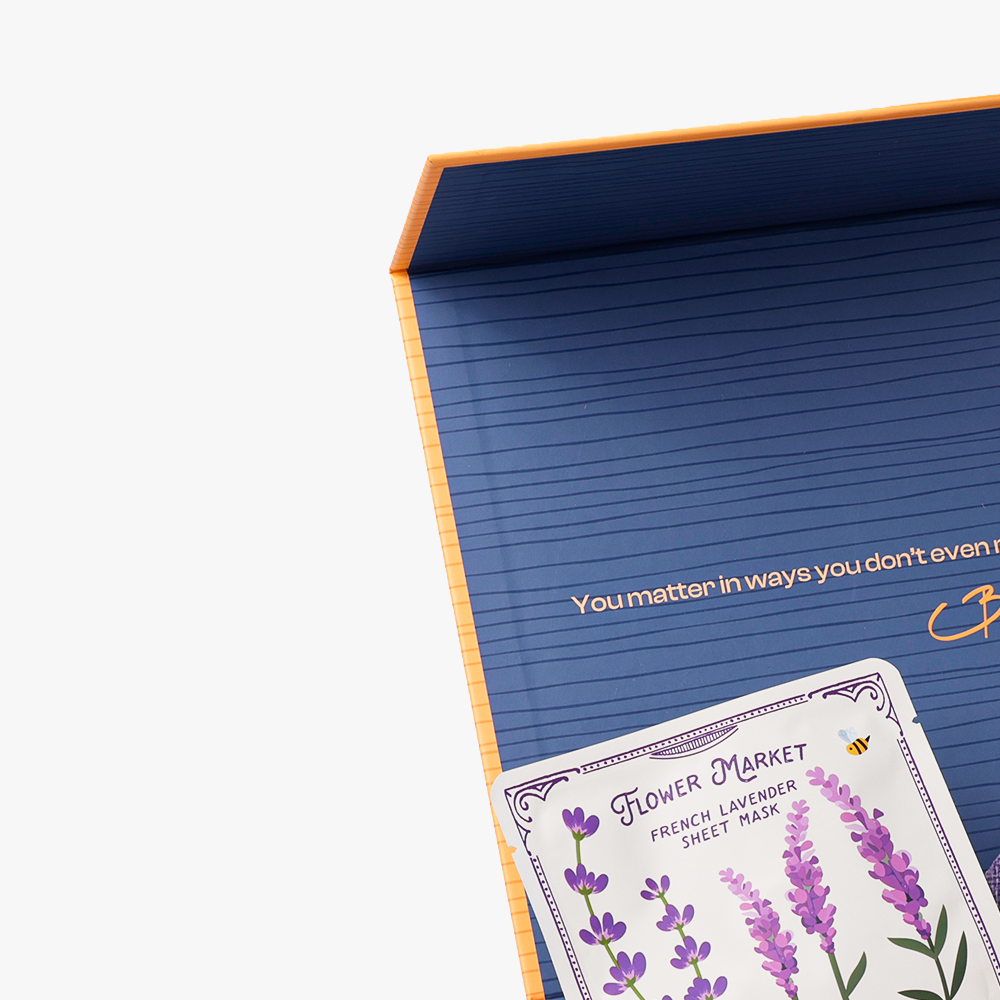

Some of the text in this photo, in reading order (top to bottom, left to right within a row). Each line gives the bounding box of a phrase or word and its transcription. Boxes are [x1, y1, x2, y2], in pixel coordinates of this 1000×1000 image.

[571, 593, 624, 614] You
[627, 580, 716, 607] matter
[719, 575, 742, 594] in
[744, 566, 812, 589] ways
[814, 559, 862, 584] you
[930, 540, 990, 561] even
[610, 743, 807, 826] FLOWER MARKET
[650, 779, 798, 842] FRENCH LAVENDER
[681, 803, 781, 849] SHEET MASK
